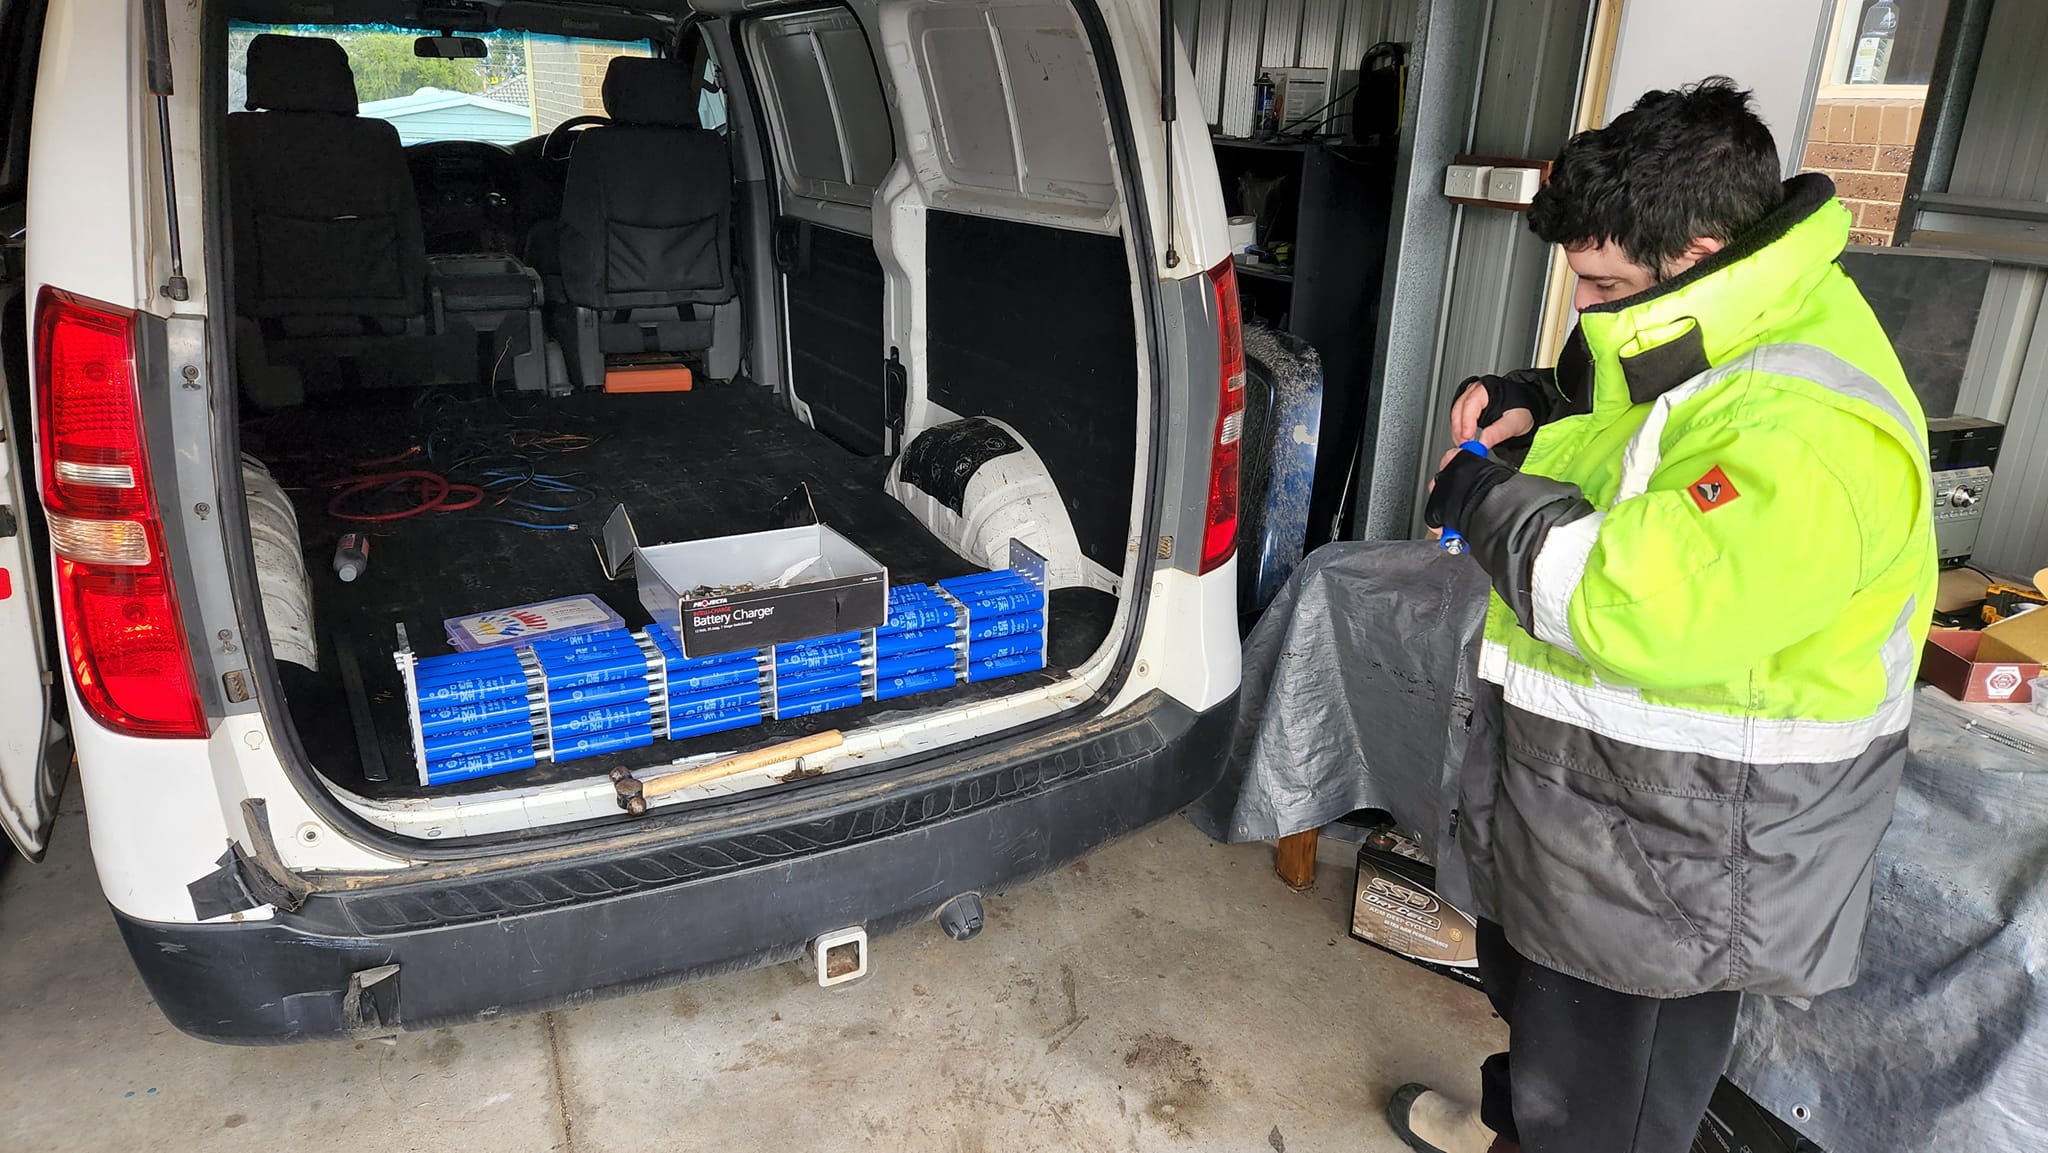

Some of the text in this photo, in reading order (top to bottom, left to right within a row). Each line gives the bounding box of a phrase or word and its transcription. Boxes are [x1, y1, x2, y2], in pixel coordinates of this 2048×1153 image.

[693, 606, 775, 627] Battery Charger
[1367, 877, 1431, 910] SSB
[1368, 906, 1427, 933] AGM DEEP CYCLE
